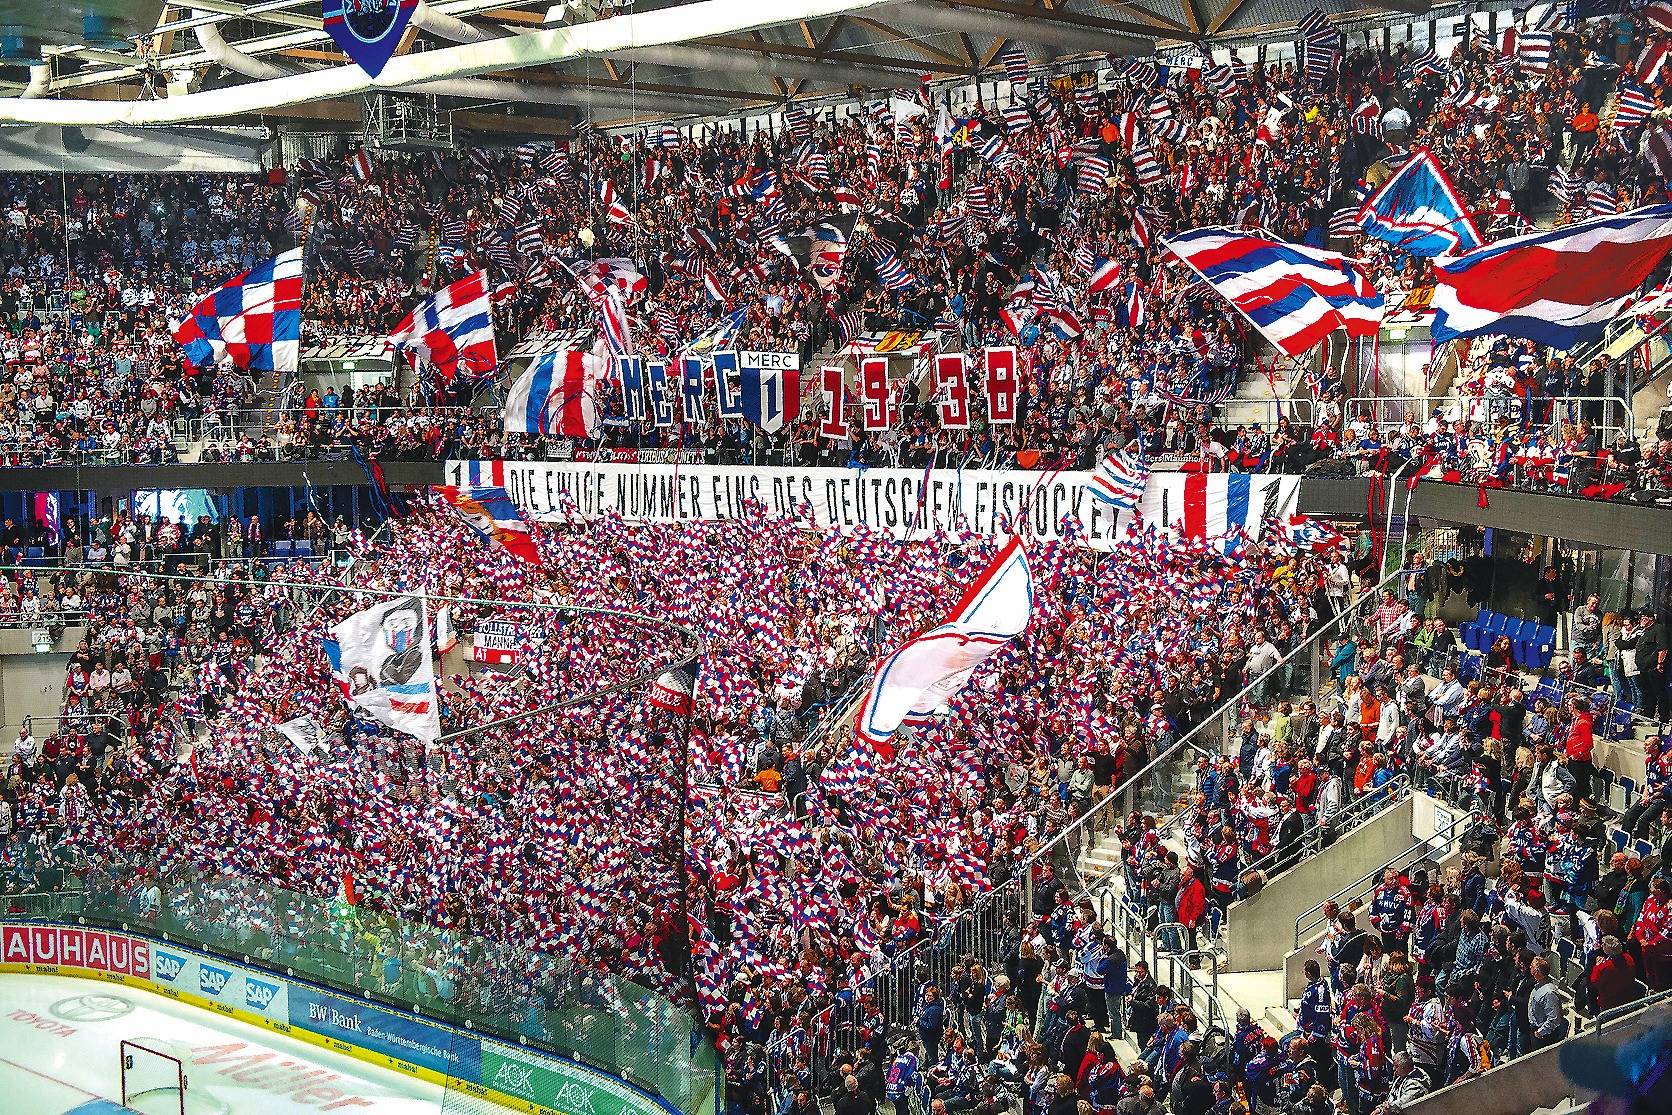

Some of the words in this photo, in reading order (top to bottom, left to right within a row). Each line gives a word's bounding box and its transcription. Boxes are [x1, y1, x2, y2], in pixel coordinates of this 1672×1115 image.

[1165, 55, 1193, 66] MERC
[748, 353, 792, 368] MERC
[510, 469, 539, 510] DIE
[617, 473, 702, 519] NUMMER
[156, 955, 181, 981] SAP
[200, 970, 225, 993] SAP
[246, 983, 273, 1007] SAP
[8, 1009, 78, 1038] TOYOTA
[366, 1025, 442, 1057] Baden-Württembergische
[443, 1050, 459, 1063] Bank
[191, 1042, 376, 1112] Müller
[496, 1061, 535, 1093] AOK
[554, 1081, 596, 1114] AOK
